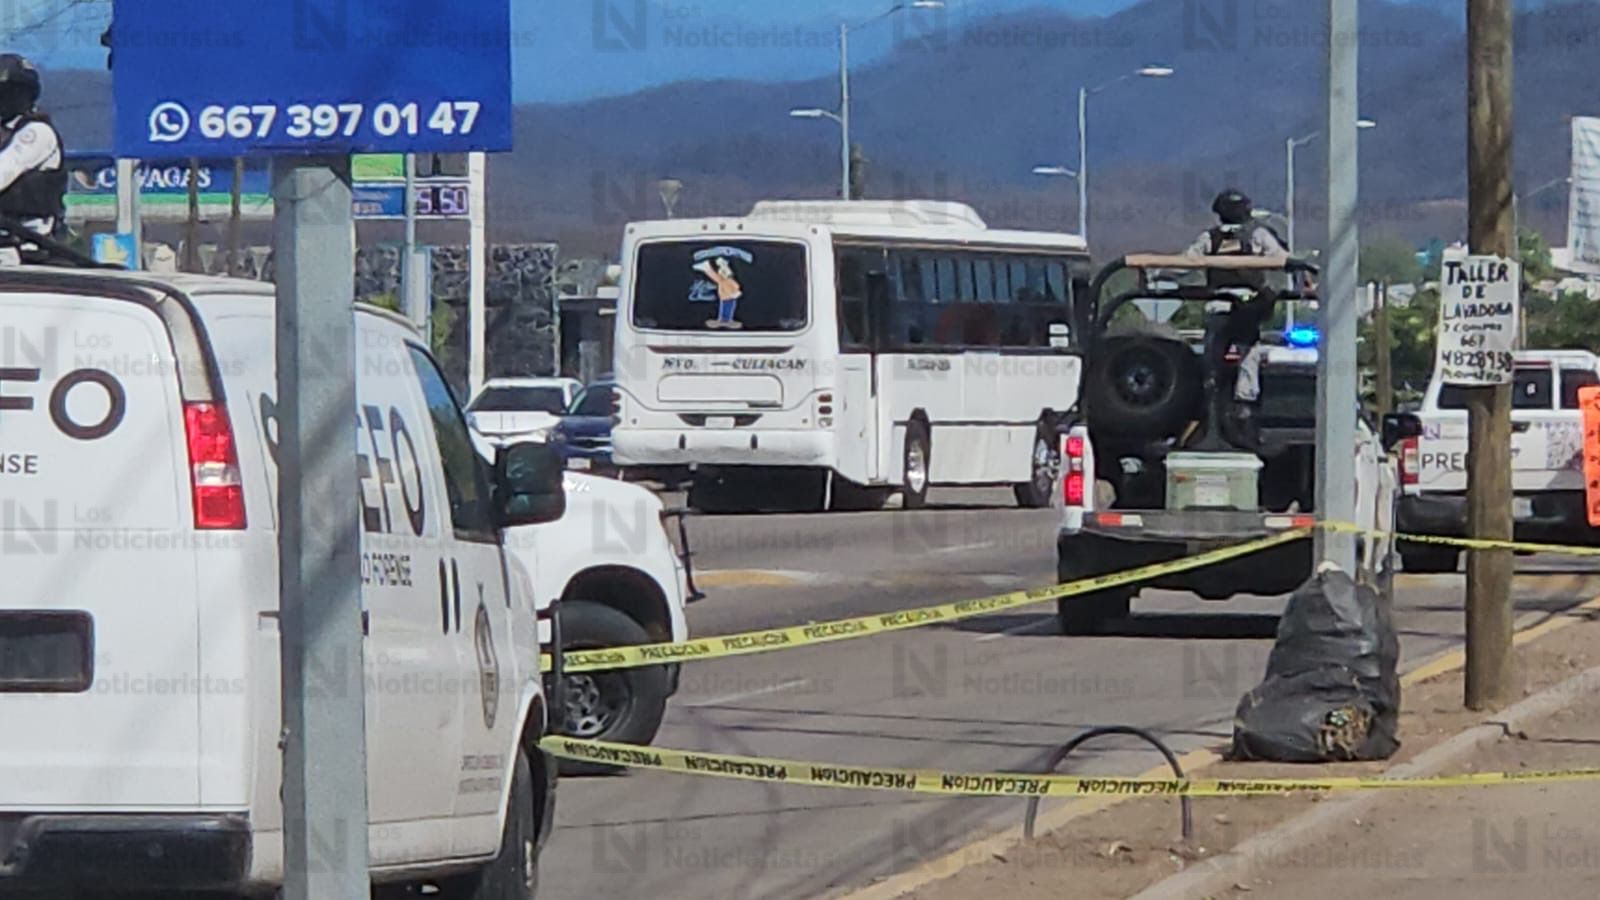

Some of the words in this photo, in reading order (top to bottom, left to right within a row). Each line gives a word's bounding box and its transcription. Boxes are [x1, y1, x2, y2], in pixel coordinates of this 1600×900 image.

[199, 105, 276, 138] 667
[286, 103, 363, 137] 397
[373, 102, 418, 136] 01
[428, 101, 480, 135] 47
[1444, 261, 1508, 285] TALLER
[1462, 285, 1486, 299] DE
[685, 755, 788, 780] PRECAUCION
[810, 766, 917, 790] PRECAUCION
[942, 773, 1050, 795] PRECAUCION
